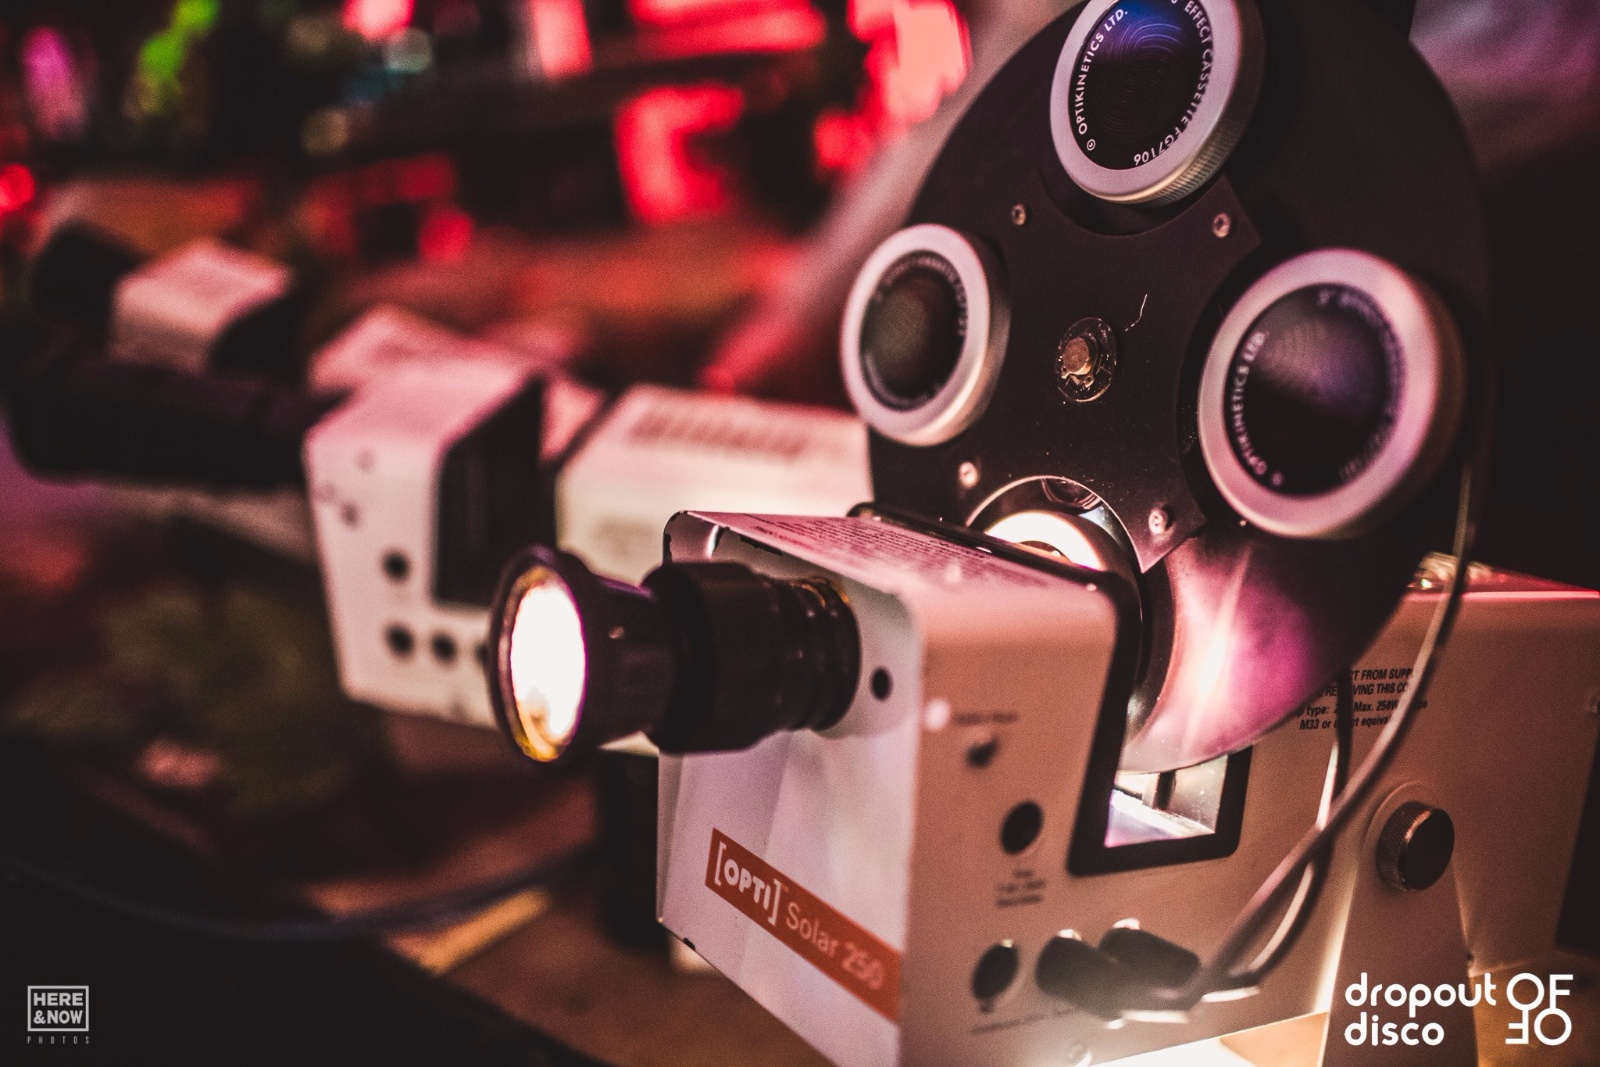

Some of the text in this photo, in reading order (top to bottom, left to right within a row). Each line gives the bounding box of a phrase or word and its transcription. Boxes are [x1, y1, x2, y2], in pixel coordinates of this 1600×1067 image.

[1074, 33, 1105, 136] OPTIKINETICS
[1104, 8, 1129, 33] LTD.
[1132, 0, 1214, 166] EFFECT CASSETTE FG7106
[1360, 669, 1387, 681] FROM
[1388, 668, 1412, 680] SUPP
[1325, 683, 1374, 697] REVING
[1376, 682, 1396, 694] THIS
[1306, 705, 1330, 718] type:
[1299, 718, 1319, 731] M33
[1321, 719, 1332, 729] or
[786, 902, 839, 957] Solar
[841, 940, 886, 991] 250
